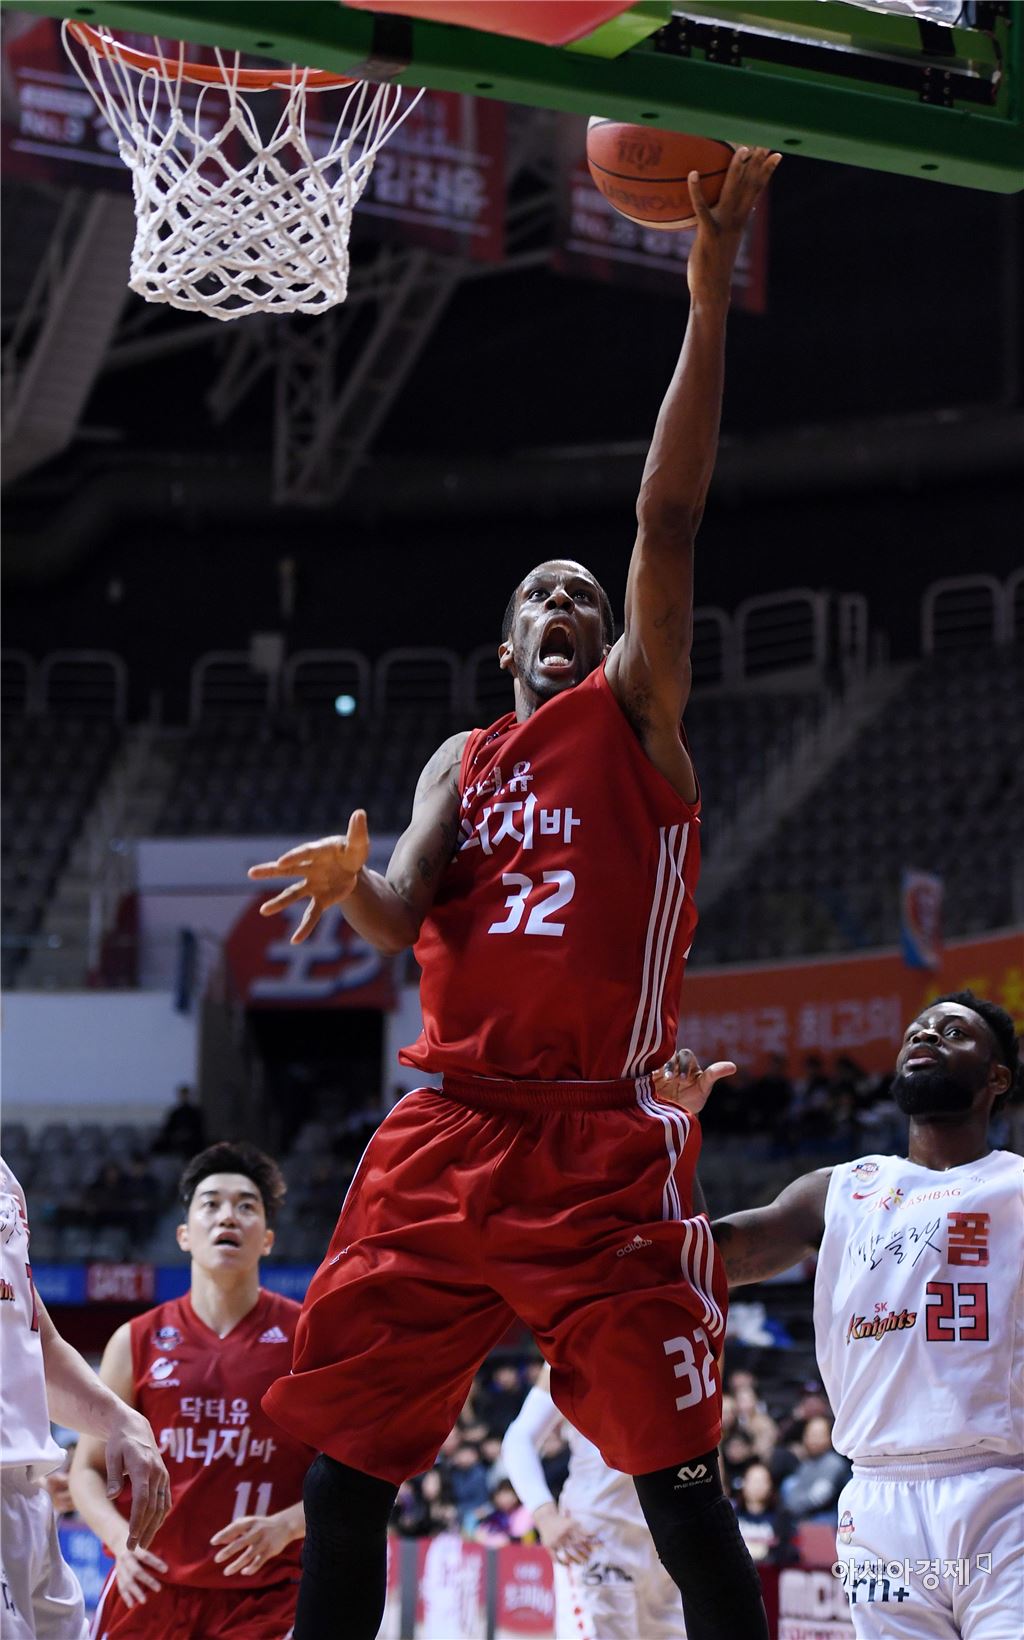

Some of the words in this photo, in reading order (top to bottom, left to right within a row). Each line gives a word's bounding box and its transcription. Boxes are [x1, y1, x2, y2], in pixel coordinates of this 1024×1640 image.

[487, 869, 576, 937] 32
[616, 1239, 653, 1257] adidas
[946, 1211, 991, 1267] 폼
[847, 1309, 917, 1345] Knights
[874, 1301, 888, 1313] SK
[925, 1281, 990, 1342] 23
[663, 1327, 717, 1412] 32
[232, 1482, 273, 1522] 11
